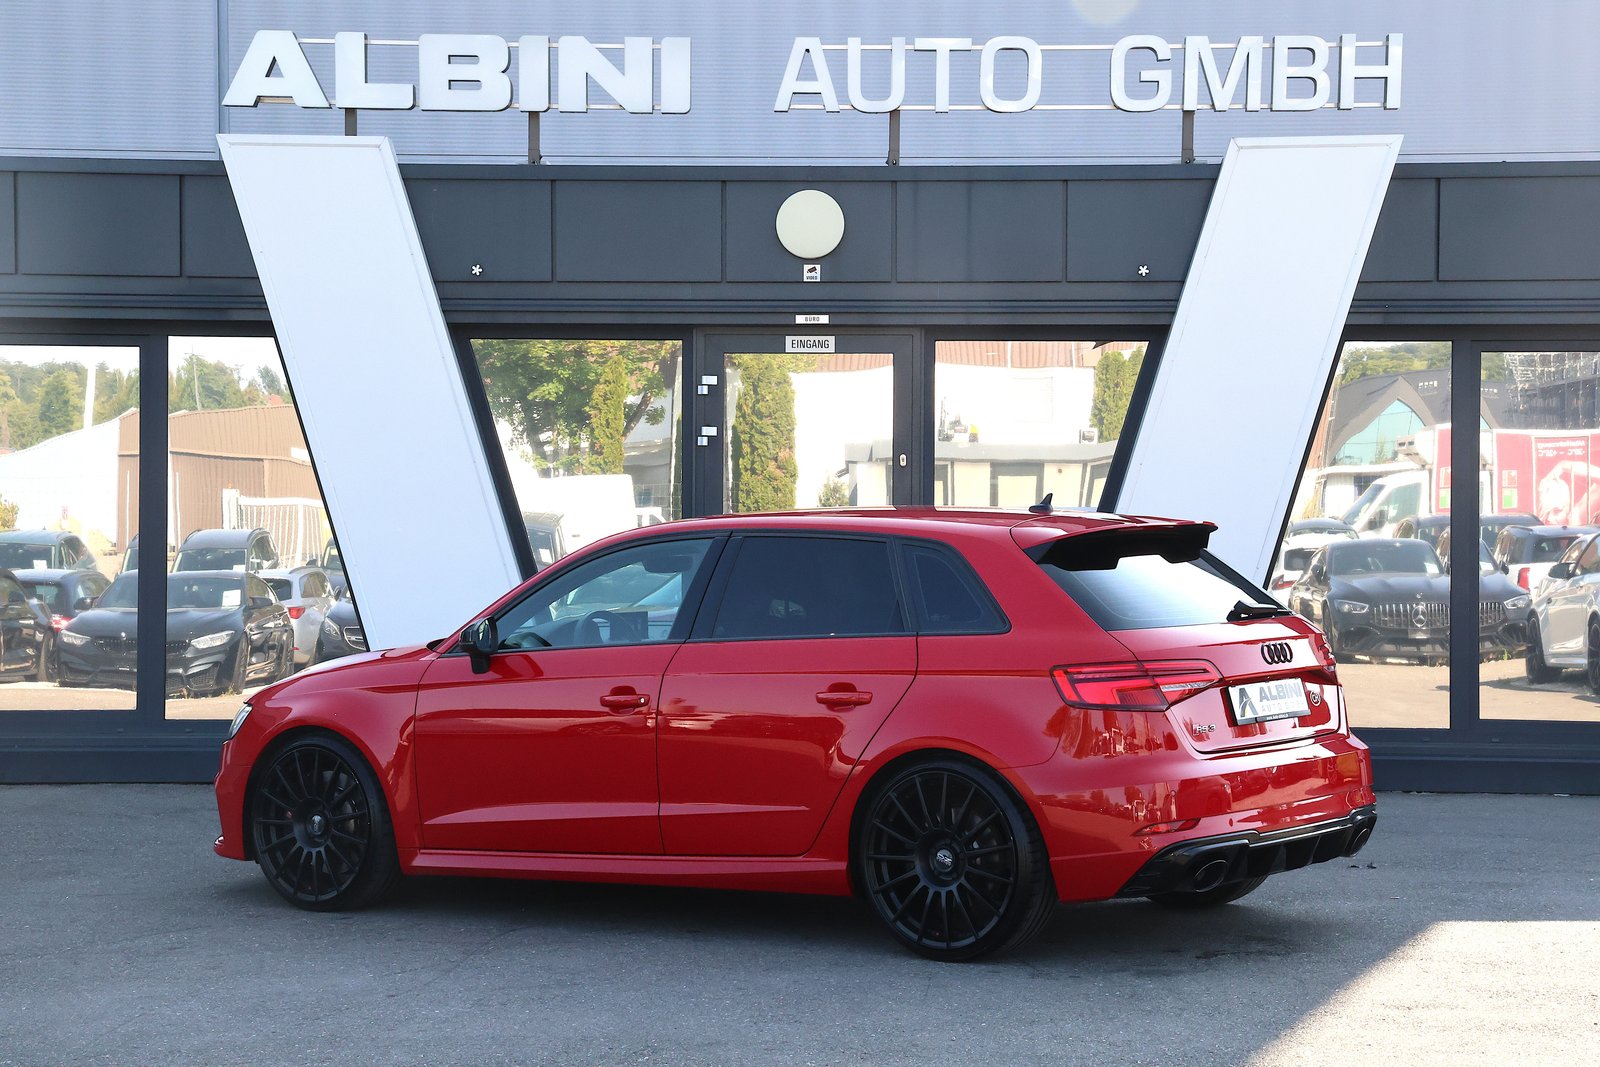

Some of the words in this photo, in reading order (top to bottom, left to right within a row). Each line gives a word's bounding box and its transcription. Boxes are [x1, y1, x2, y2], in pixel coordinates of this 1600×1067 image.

[222, 30, 691, 114] ALBINI
[774, 35, 1042, 113] AUTO
[1110, 33, 1404, 113] GMBH
[791, 339, 830, 349] EINGANG
[1259, 682, 1303, 702] ALBINI
